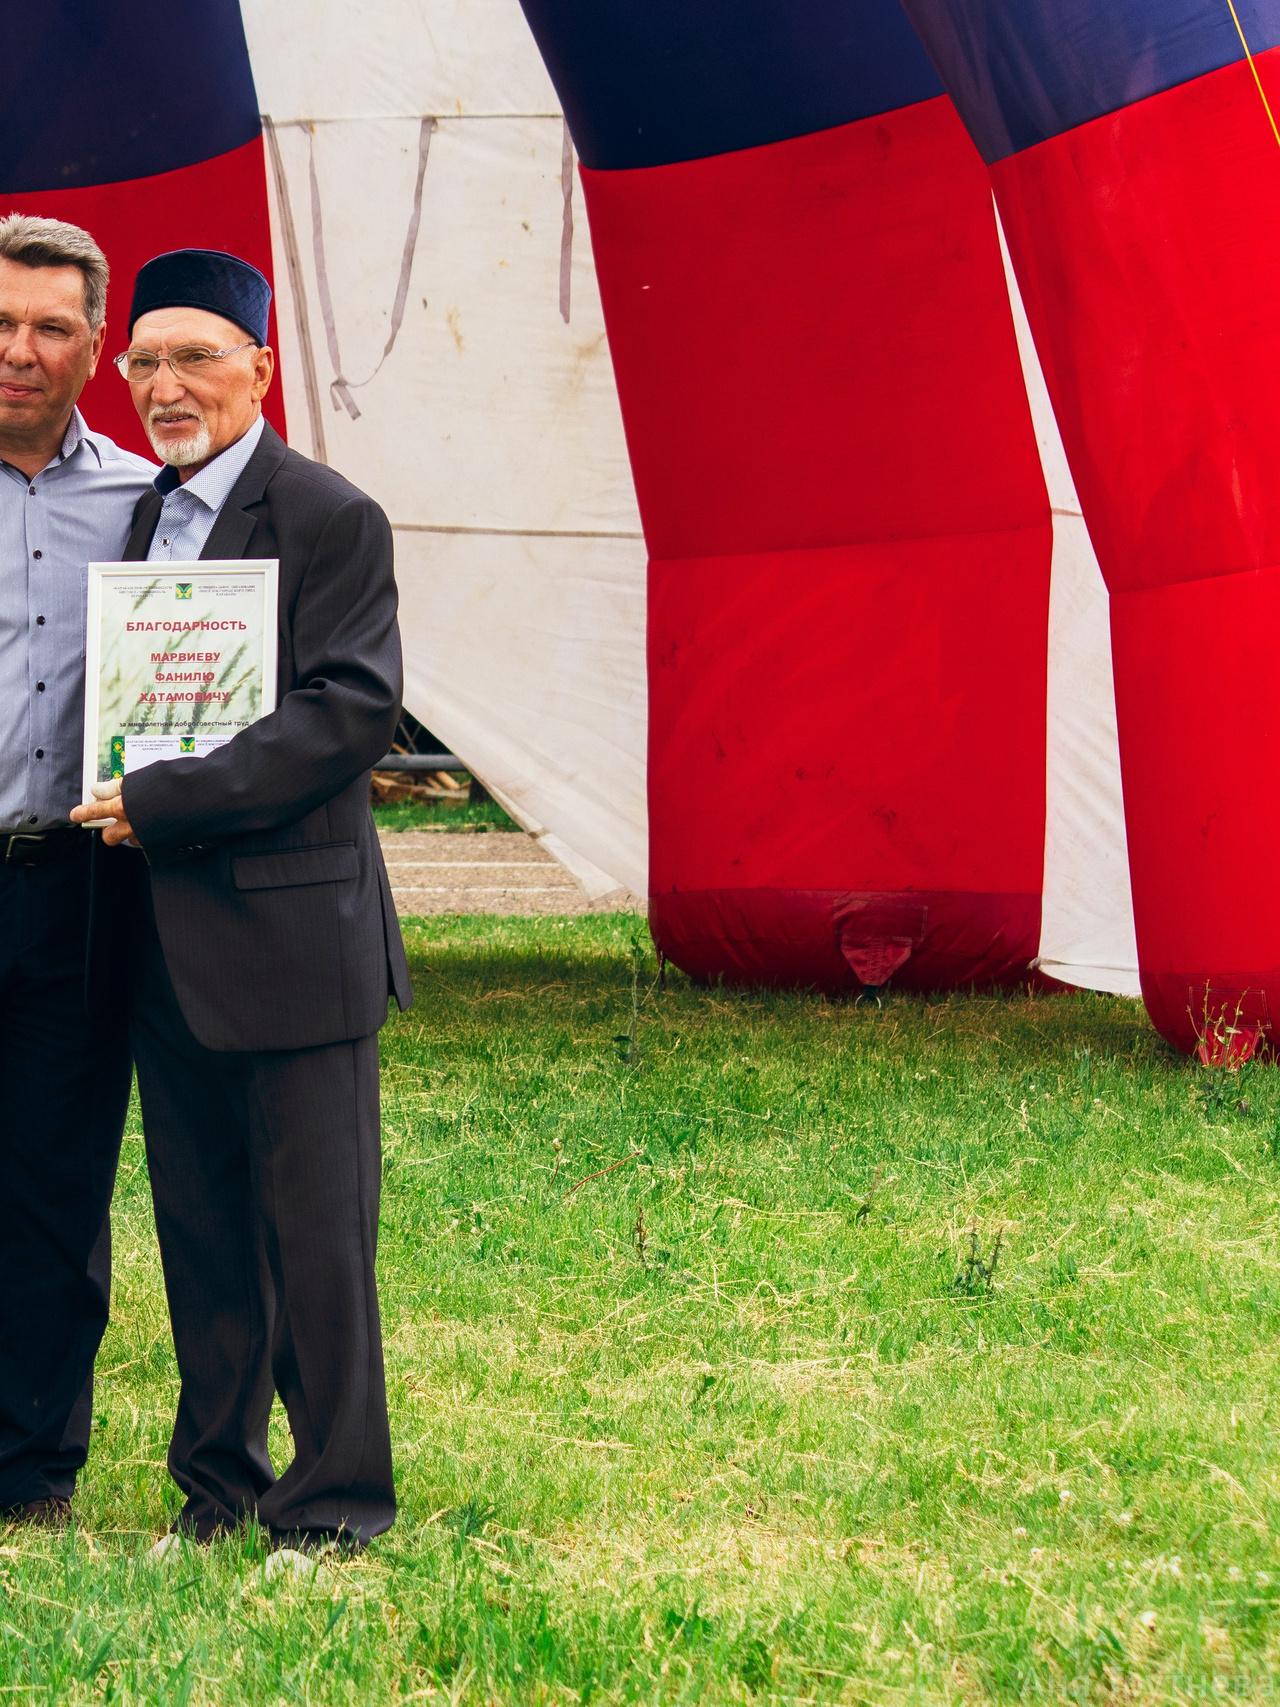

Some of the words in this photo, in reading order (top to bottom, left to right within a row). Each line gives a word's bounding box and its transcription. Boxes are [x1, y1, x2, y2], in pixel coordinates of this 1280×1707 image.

[126, 620, 247, 632] БЛАГОДАРНОСТЬ
[150, 652, 221, 662] МАРВИЕВУ
[155, 671, 215, 682] ФАНИЛЮ
[140, 691, 230, 702] ХАТАМОВИЧУ
[128, 720, 173, 728] многолетний
[174, 720, 232, 728] добросовестный
